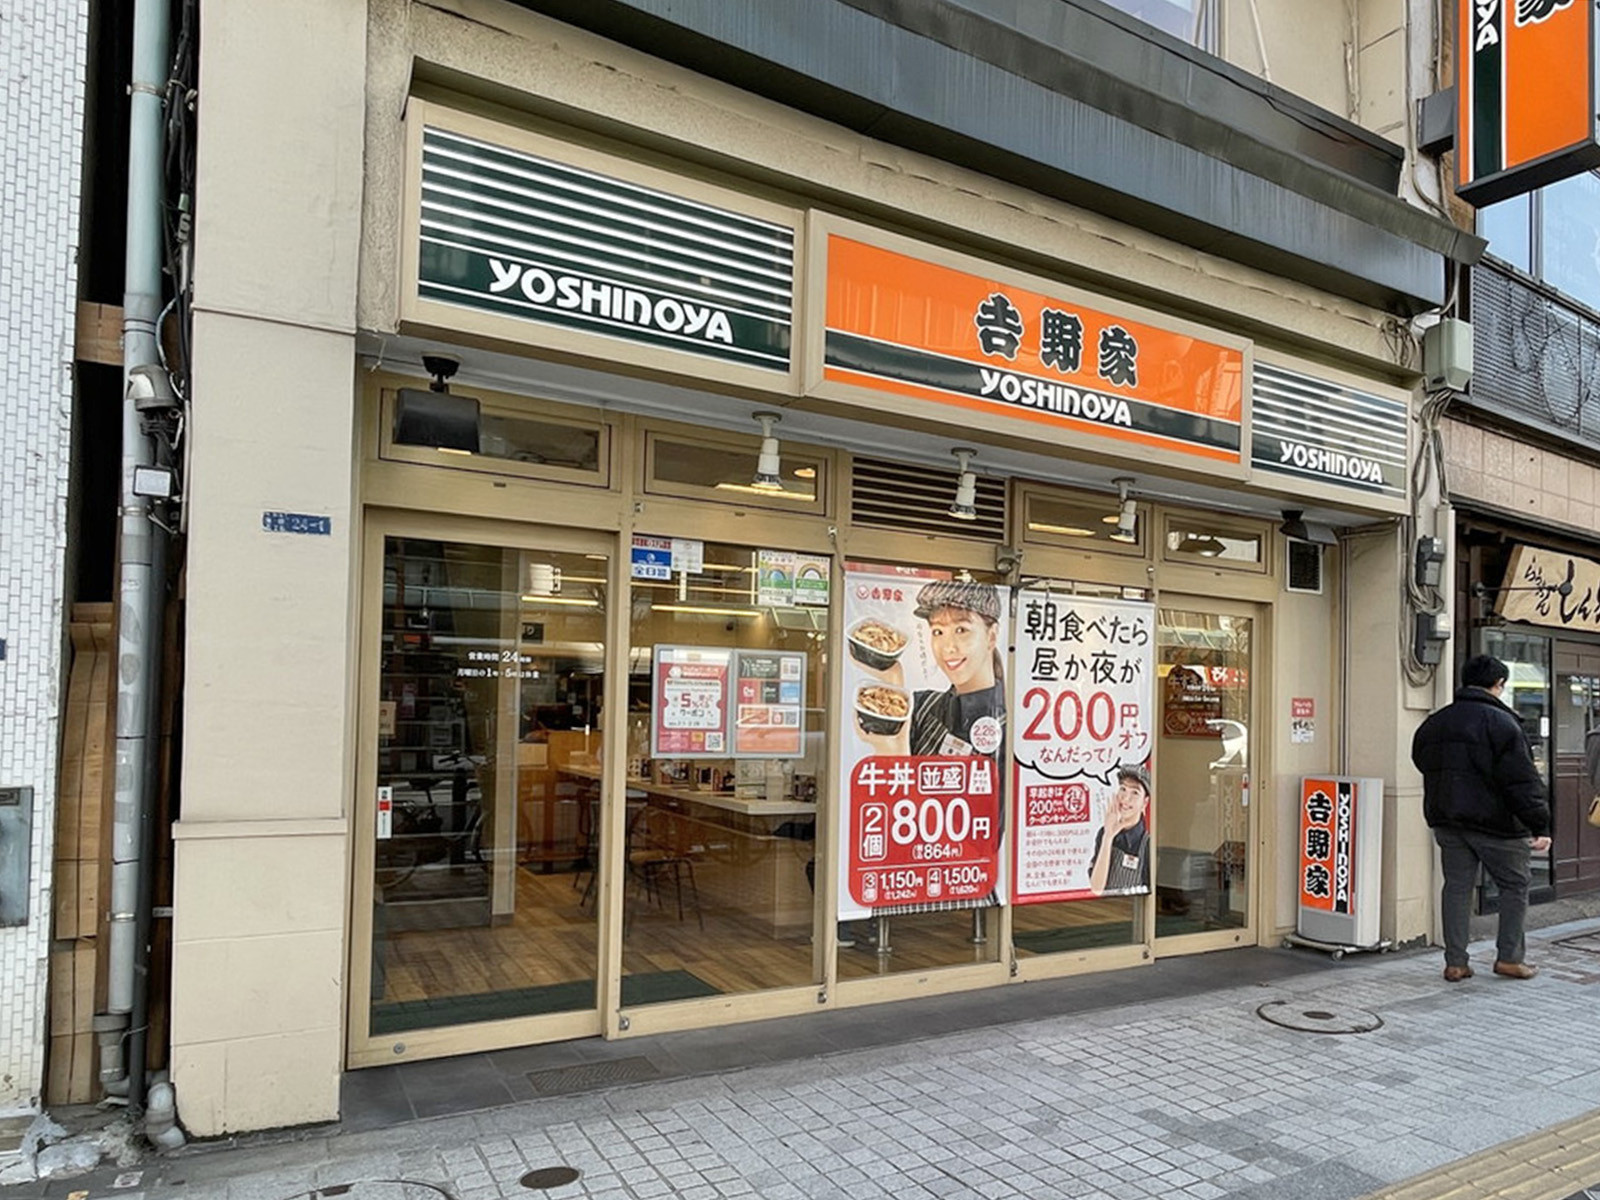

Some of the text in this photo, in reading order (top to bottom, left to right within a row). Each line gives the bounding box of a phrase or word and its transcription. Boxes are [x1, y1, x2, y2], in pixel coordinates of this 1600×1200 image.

[488, 258, 734, 345] YOSHINOYA
[980, 369, 1132, 427] YOSHINOYA
[1280, 441, 1383, 484] YOSHINOYA
[1024, 599, 1149, 646] 朝食べたら
[1031, 647, 1142, 685] 昼か夜が
[922, 767, 963, 790] 並盛
[891, 798, 991, 845] 800円
[1304, 790, 1334, 898] 吉野家
[1337, 793, 1350, 902] YOSHINOYA
